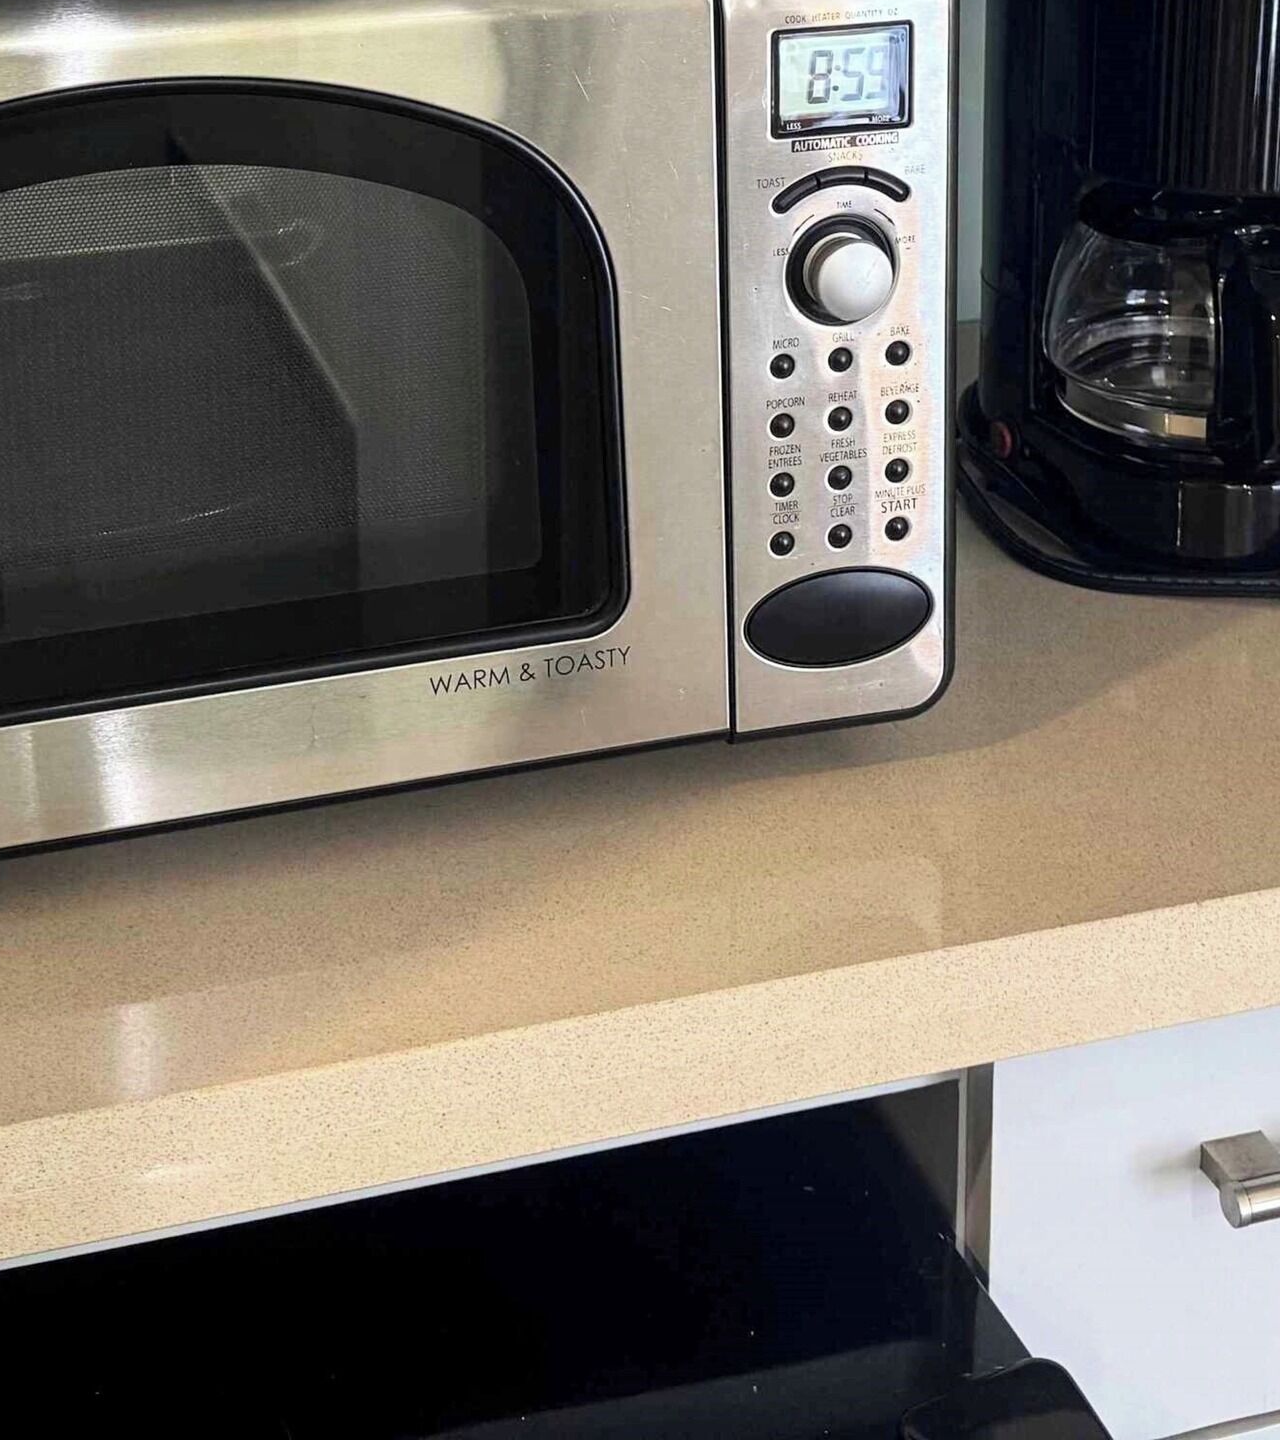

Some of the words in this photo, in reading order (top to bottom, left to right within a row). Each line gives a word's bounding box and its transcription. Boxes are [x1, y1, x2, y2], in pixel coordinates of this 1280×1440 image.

[793, 136, 851, 152] AUTOMATIC
[855, 132, 898, 147] COOKING
[828, 151, 863, 162] SNACKS
[757, 177, 786, 188] TOAST
[836, 200, 852, 208] TIME
[895, 235, 916, 244] MORE
[773, 248, 790, 257] LESS
[832, 332, 855, 343] GRILL
[890, 326, 910, 337] BAKE
[772, 337, 800, 350] MICRO
[828, 390, 858, 402] REHEAT
[880, 384, 920, 397] BEVERAGE
[766, 396, 805, 409] POPCORN
[831, 438, 855, 448] FRESH
[883, 431, 916, 443] EXPRESS
[769, 444, 802, 456] FROZEN
[882, 442, 917, 455] DEFROST
[819, 448, 867, 463] VEGETABLES
[768, 457, 802, 469] ENTREES
[875, 488, 904, 500] MINUTE
[905, 483, 926, 495] PLUS
[774, 500, 799, 511] TIMER
[832, 494, 853, 505] STOP
[830, 506, 855, 517] CLEAR
[881, 498, 918, 514] START
[772, 514, 800, 525] CLOCK
[429, 666, 510, 696] WARM
[519, 662, 536, 682] &
[543, 646, 631, 678] TOASTY
